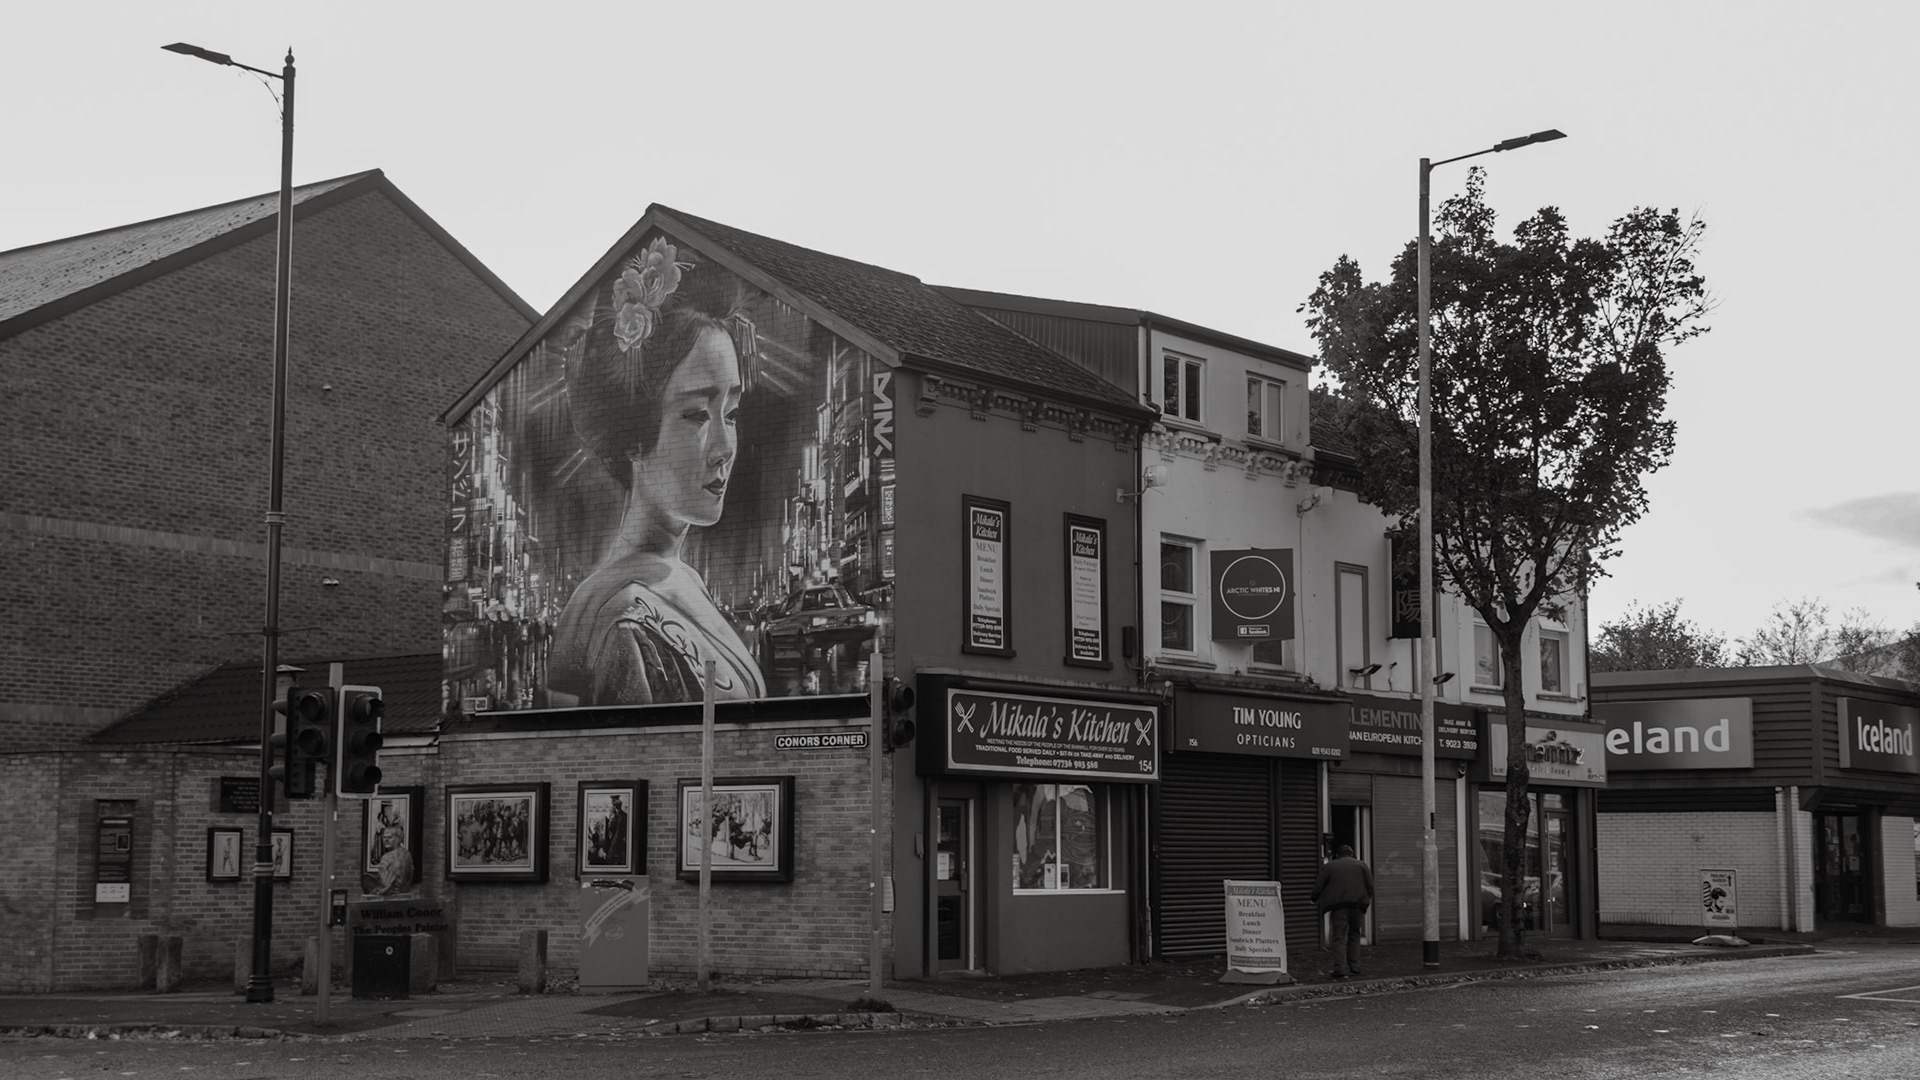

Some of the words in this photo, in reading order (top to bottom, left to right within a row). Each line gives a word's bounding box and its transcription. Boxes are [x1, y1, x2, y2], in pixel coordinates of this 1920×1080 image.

[1250, 586, 1273, 594] WHITES
[979, 700, 1063, 740] Mikala's
[1068, 708, 1131, 744] Kitchen
[1232, 706, 1255, 726] TIM
[1258, 709, 1301, 730] YOUNG
[1349, 706, 1423, 730] LEMENTIN
[778, 736, 820, 747] CONORS
[822, 735, 864, 746] CORNER
[1189, 738, 1198, 747] 156
[1236, 733, 1296, 748] OPTICIANS
[1349, 730, 1363, 740] IAN
[1363, 731, 1402, 744] EUROPEAN
[1403, 735, 1423, 746] KITCH
[1605, 718, 1730, 755] eland
[1857, 715, 1913, 757] Iceland
[1445, 739, 1462, 749] 9023
[1462, 740, 1477, 750] 3939
[975, 744, 1008, 752] TRADITIONAL
[1022, 747, 1042, 755] SERVED
[1080, 751, 1104, 759] TAKE-AWAY
[1113, 753, 1135, 761] DELIVERY
[1016, 755, 1052, 767] Telephone:
[1053, 759, 1073, 768] 07736
[1073, 760, 1086, 769] 903
[1138, 760, 1152, 772] 154
[1237, 898, 1267, 908] MENU
[360, 909, 403, 920] William
[407, 907, 443, 918] Conor
[352, 925, 371, 934] The
[415, 922, 449, 932] Painter
[1248, 946, 1273, 954] Specials
